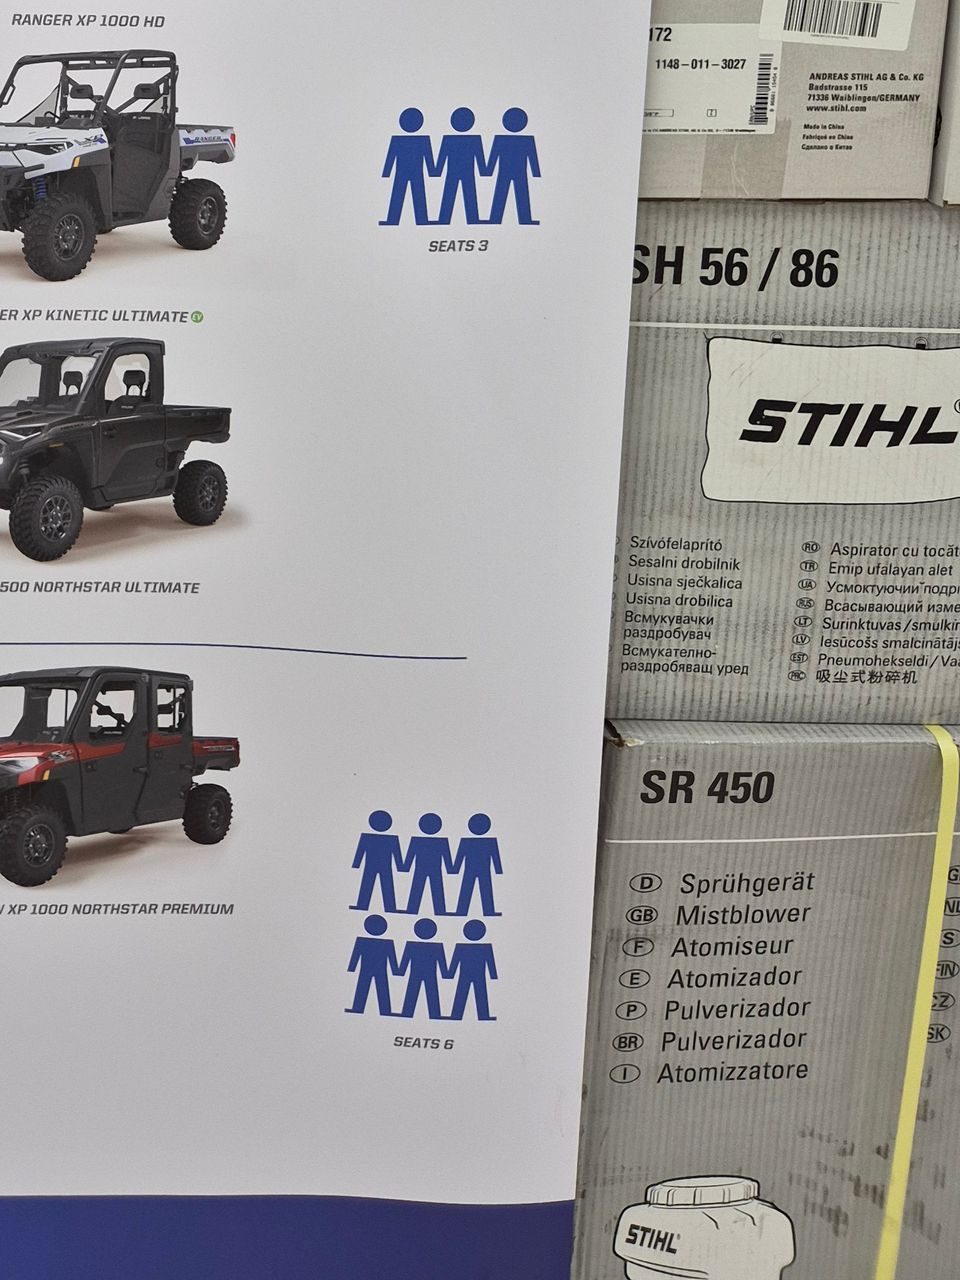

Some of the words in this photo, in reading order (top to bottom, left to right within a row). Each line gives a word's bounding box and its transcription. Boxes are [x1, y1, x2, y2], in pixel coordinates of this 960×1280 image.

[11, 13, 73, 26] RANGER
[76, 14, 98, 27] XP
[100, 15, 140, 28] 1000
[143, 16, 166, 28] HD
[649, 27, 672, 42] 172
[428, 240, 476, 252] SEATS
[478, 240, 489, 252] 3
[699, 247, 750, 287] 56
[789, 248, 840, 288] 86
[22, 308, 42, 322] XP
[44, 308, 108, 322] KINETIC
[112, 310, 190, 324] ULTIMATE
[738, 398, 959, 448] STIHL
[630, 535, 723, 552] Szívófelaprító
[830, 542, 898, 558] Aspirator
[902, 546, 918, 558] cu
[628, 554, 678, 568] Sesalni
[681, 556, 741, 571] drobilnik
[828, 562, 863, 578] Emip
[867, 562, 924, 578] ufalayan
[928, 564, 953, 576] alet
[33, 580, 121, 594] NORTHSTAR
[124, 580, 200, 594] ULTIMATE
[627, 573, 672, 587] Usisna
[676, 576, 743, 590] sječkalica
[626, 592, 671, 606] Usisna
[674, 594, 733, 608] drobilica
[824, 598, 923, 614] Всасывающий
[624, 610, 714, 626] Всмукувачки
[623, 626, 712, 642] раздробувач
[622, 643, 717, 658] Всмукателно-
[620, 660, 714, 674] раздробяващ
[717, 664, 749, 676] уред
[816, 670, 918, 684] 吸尘式粉碎机
[640, 769, 695, 804] SR
[707, 770, 776, 804] 450
[680, 872, 816, 898] Sprühgerät
[7, 904, 28, 916] XP
[30, 904, 68, 916] 1000
[71, 903, 158, 916] NORTHSTAR
[160, 902, 234, 916] PREMIUM
[676, 904, 812, 926] Mistblower
[670, 936, 794, 958] Atomiseur
[666, 966, 803, 989] Atomizador
[664, 996, 812, 1021] Pulverizador
[393, 1036, 440, 1050] SEATS
[443, 1039, 455, 1050] 6
[662, 1028, 808, 1052] Pulverizador
[656, 1061, 809, 1084] Atomizzatore
[624, 1224, 678, 1254] STIHL
